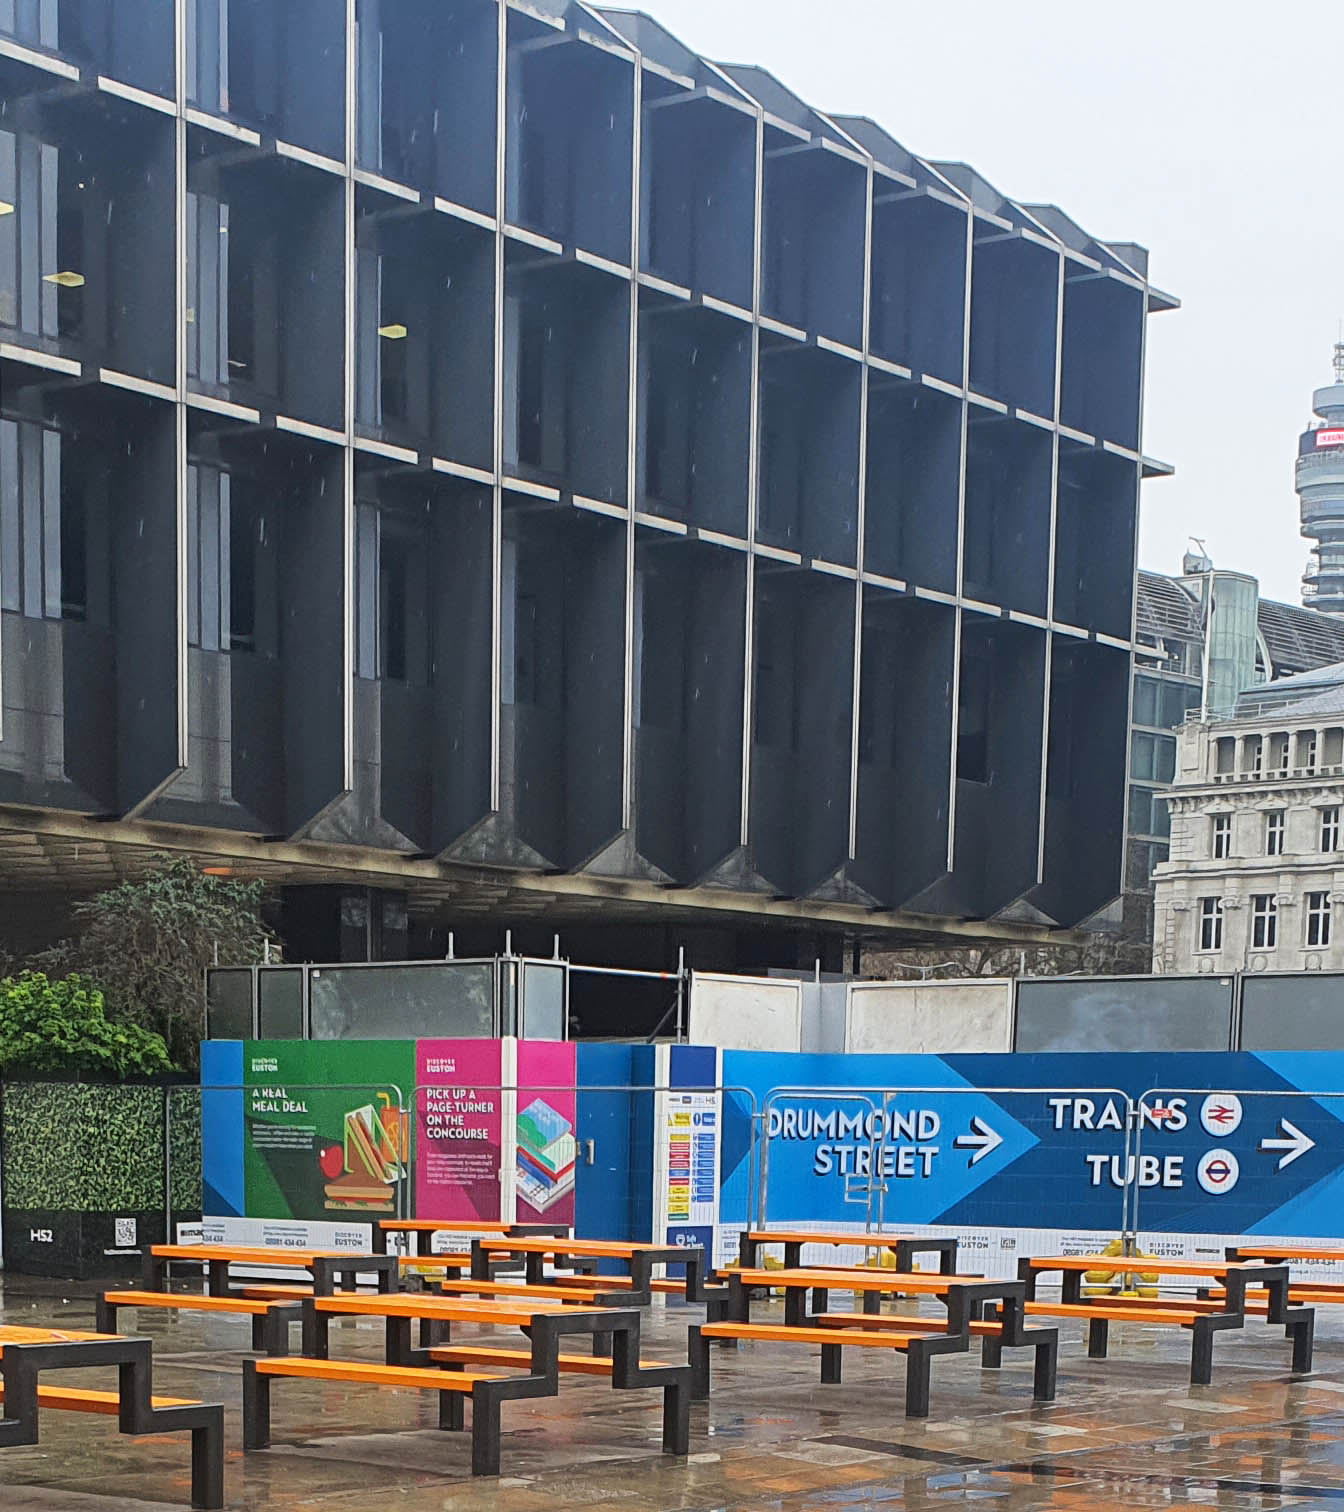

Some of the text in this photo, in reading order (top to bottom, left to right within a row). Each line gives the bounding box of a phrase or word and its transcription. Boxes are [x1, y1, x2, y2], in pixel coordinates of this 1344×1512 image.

[252, 1088, 260, 1098] A
[426, 1088, 476, 1100] PICK UP A
[252, 1100, 309, 1113] MEAL DEAL
[426, 1101, 494, 1113] PAGE-TURNER
[426, 1114, 464, 1126] ON THE
[1048, 1097, 1188, 1131] TRAINS
[768, 1107, 941, 1141] DRUMMOND
[426, 1127, 489, 1139] CONCOURSE
[814, 1144, 939, 1175] STREET
[1086, 1154, 1184, 1187] TUBE
[30, 1229, 54, 1242] HS2
[1150, 1248, 1184, 1256] EUSTON
